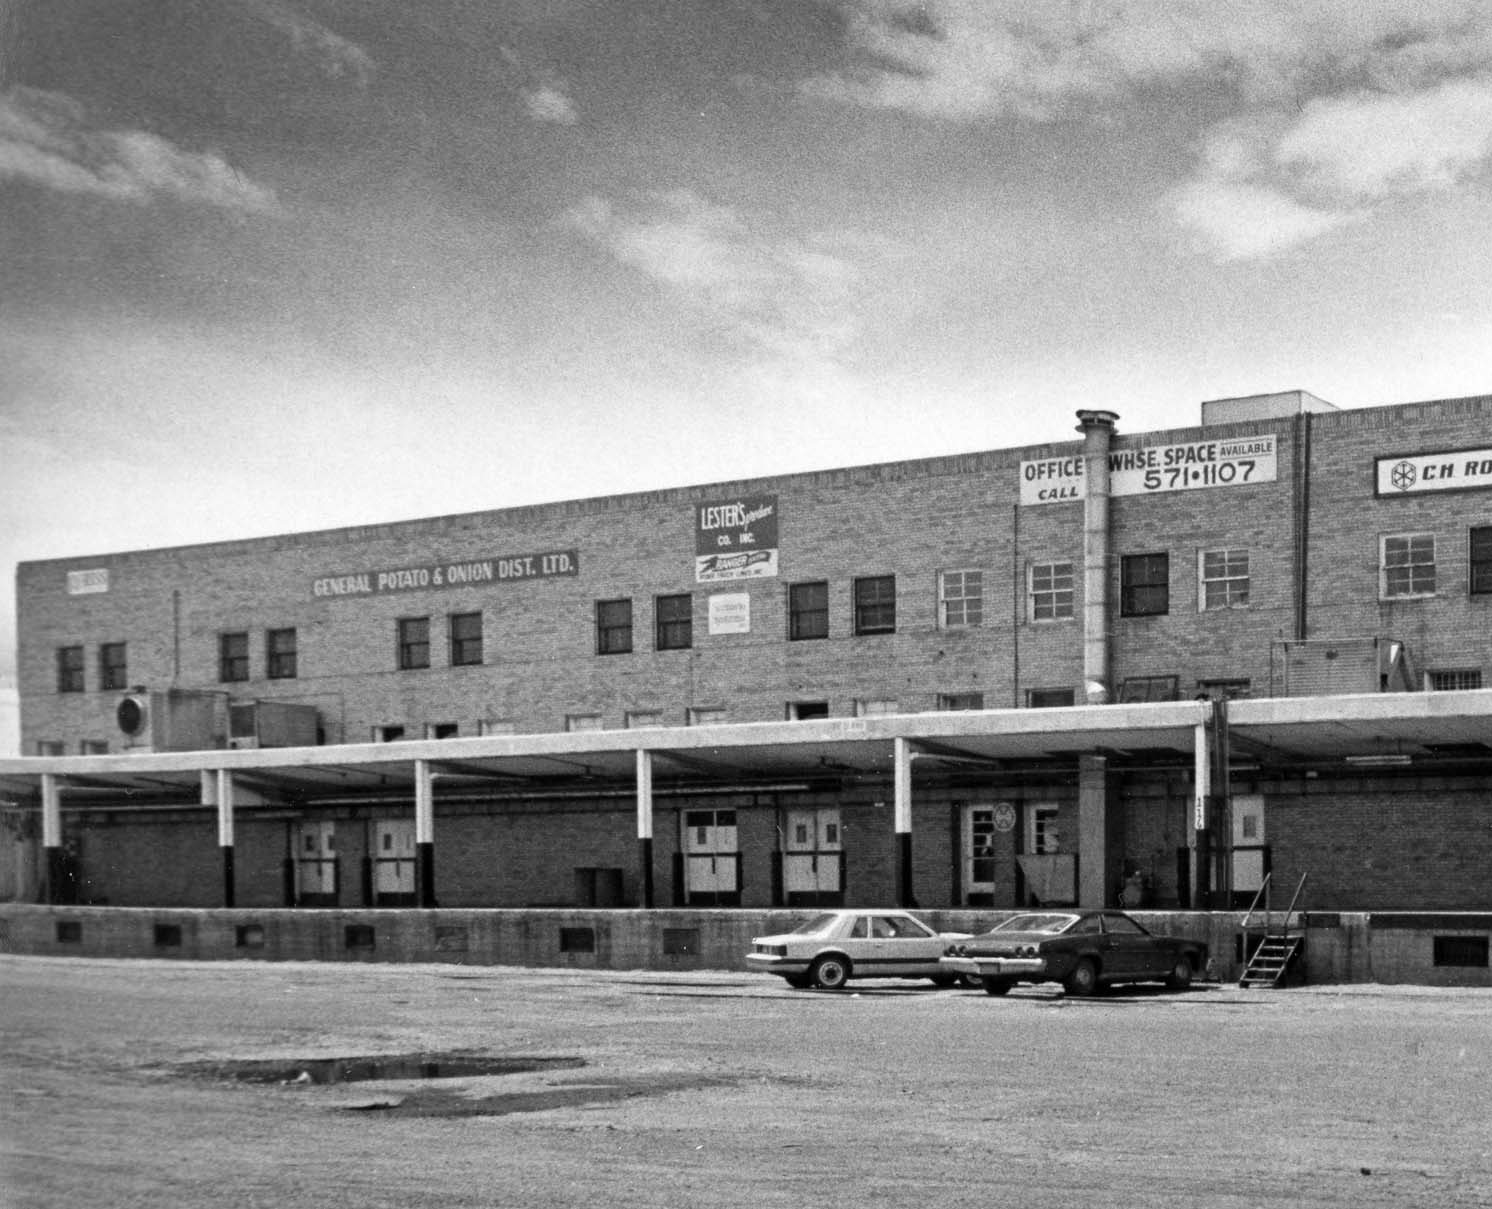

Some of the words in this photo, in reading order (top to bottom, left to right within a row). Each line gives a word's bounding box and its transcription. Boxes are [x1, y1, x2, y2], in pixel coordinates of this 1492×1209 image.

[1025, 458, 1084, 481] OFFICE
[1109, 450, 1160, 472] WHSE.
[1163, 444, 1217, 466] SPACE
[1219, 442, 1273, 457] AVAILABLE
[1038, 487, 1079, 500] CALL
[701, 501, 745, 530] LESTER'S
[313, 574, 372, 596] GENERAL
[378, 569, 429, 591] POTATO
[432, 567, 443, 585] &
[447, 562, 493, 583] ONION
[499, 557, 537, 578] DIST.
[542, 554, 574, 574] LTD.
